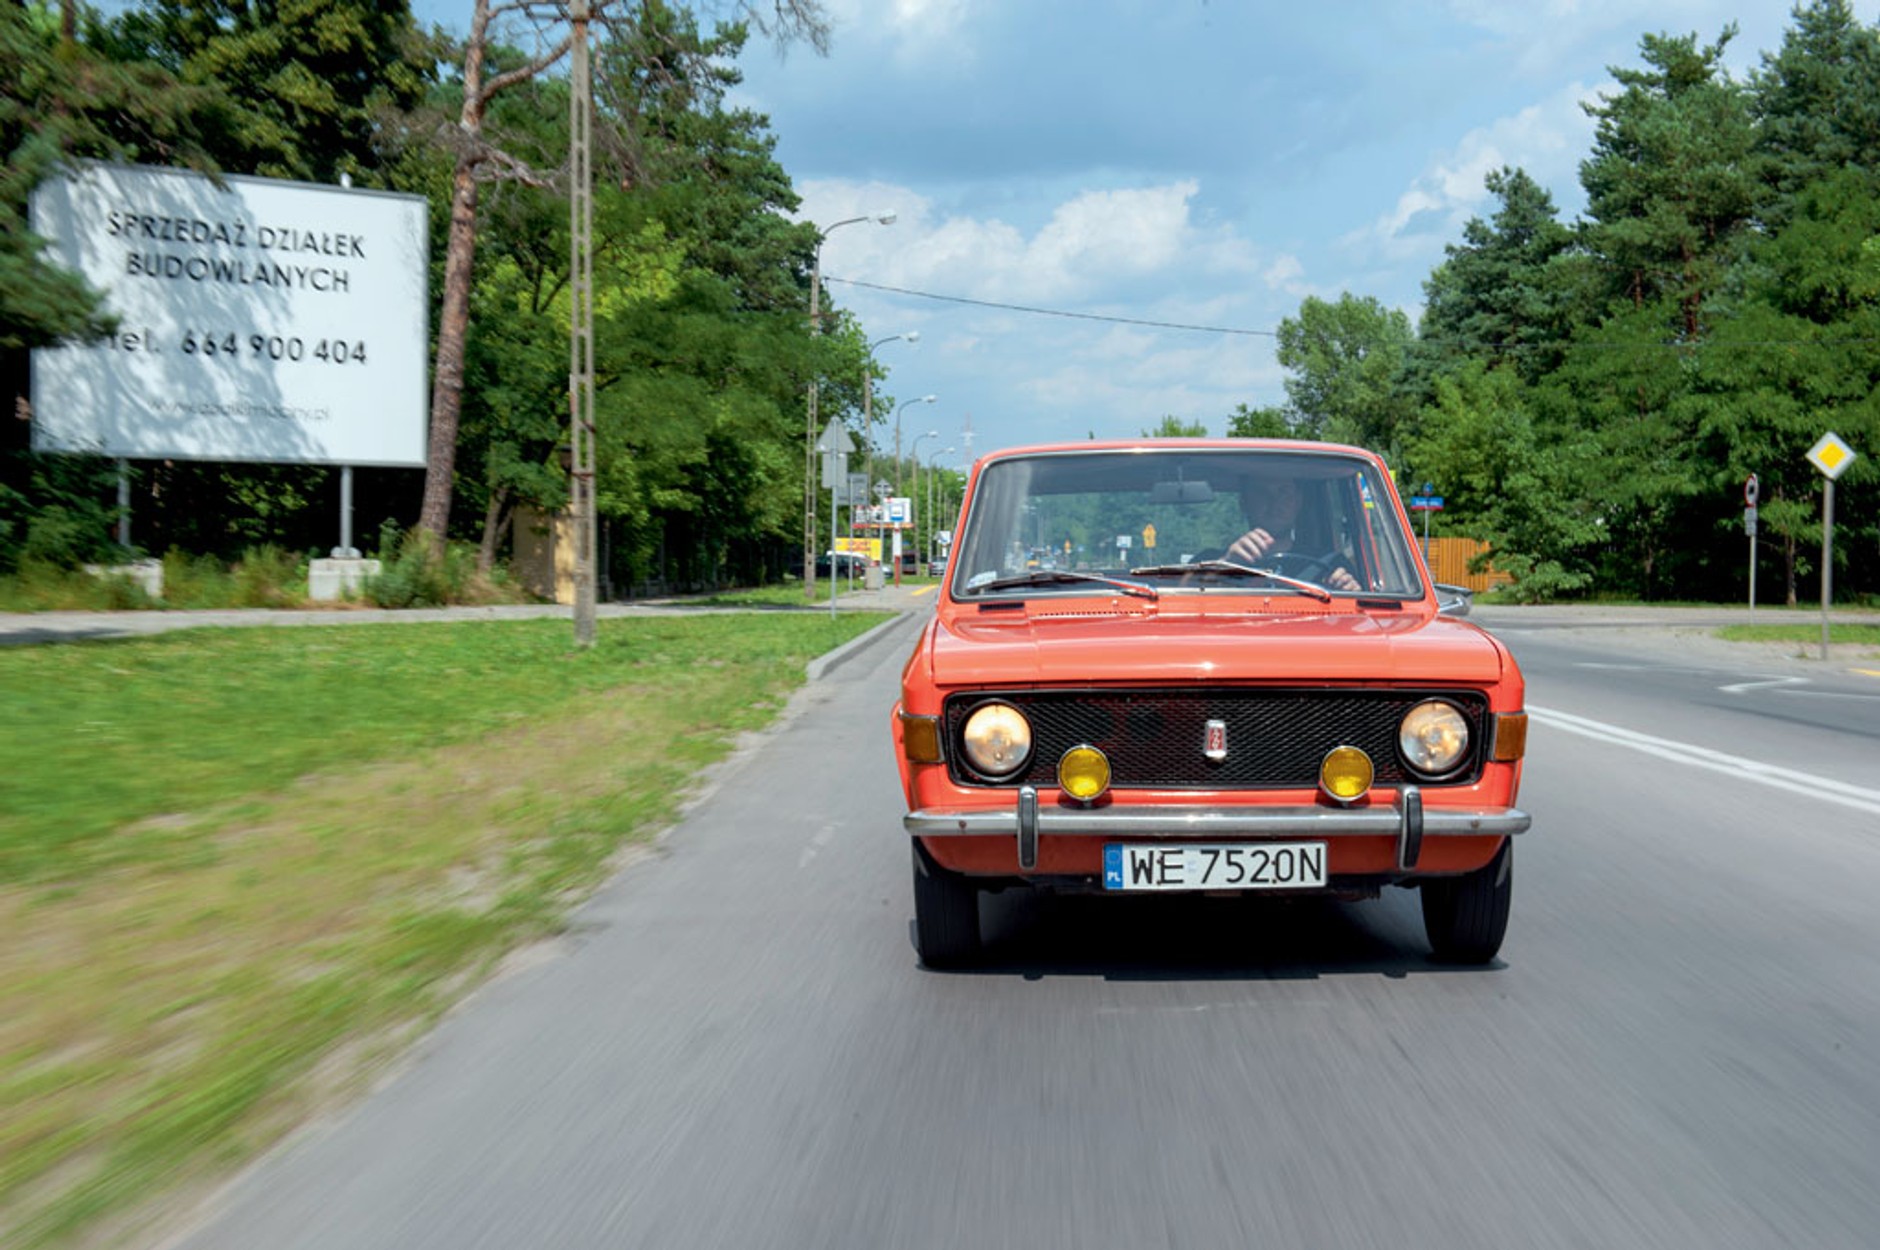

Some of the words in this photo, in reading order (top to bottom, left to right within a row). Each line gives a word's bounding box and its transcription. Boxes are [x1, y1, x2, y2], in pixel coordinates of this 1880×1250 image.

[107, 212, 247, 248] SPRZEDAŻ
[258, 225, 366, 259] DZIAŁEK
[126, 252, 350, 293] BUDOWLANYCH
[181, 328, 238, 357] 664
[249, 333, 304, 362] 900
[313, 338, 367, 364] 404
[1107, 871, 1121, 882] PL
[1130, 850, 1185, 885] WE
[1199, 848, 1322, 884] 7520N
